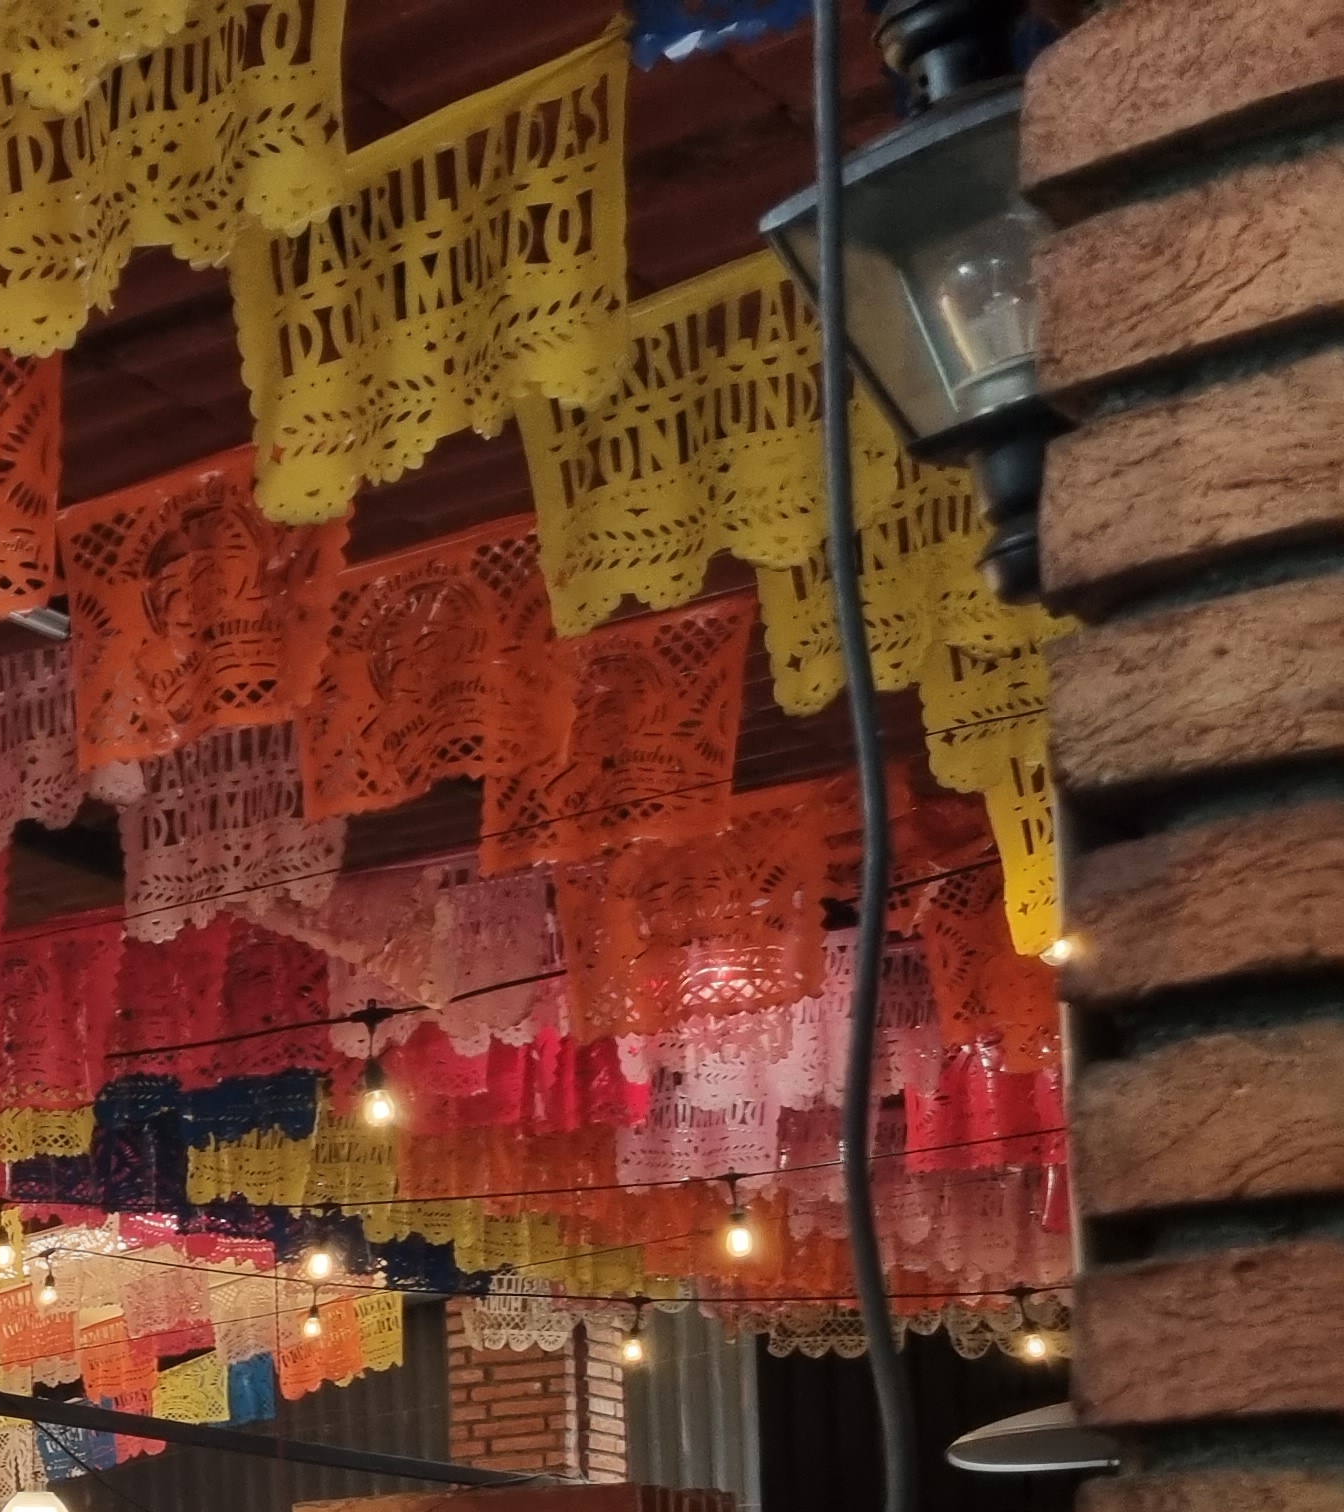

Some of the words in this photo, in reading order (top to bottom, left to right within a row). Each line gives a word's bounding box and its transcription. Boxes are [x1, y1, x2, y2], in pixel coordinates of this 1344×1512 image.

[270, 74, 604, 293] PARRILLADAS
[279, 266, 398, 374] DON
[402, 192, 584, 318] MUNDO
[564, 412, 678, 502] DON
[682, 366, 820, 458] MUND
